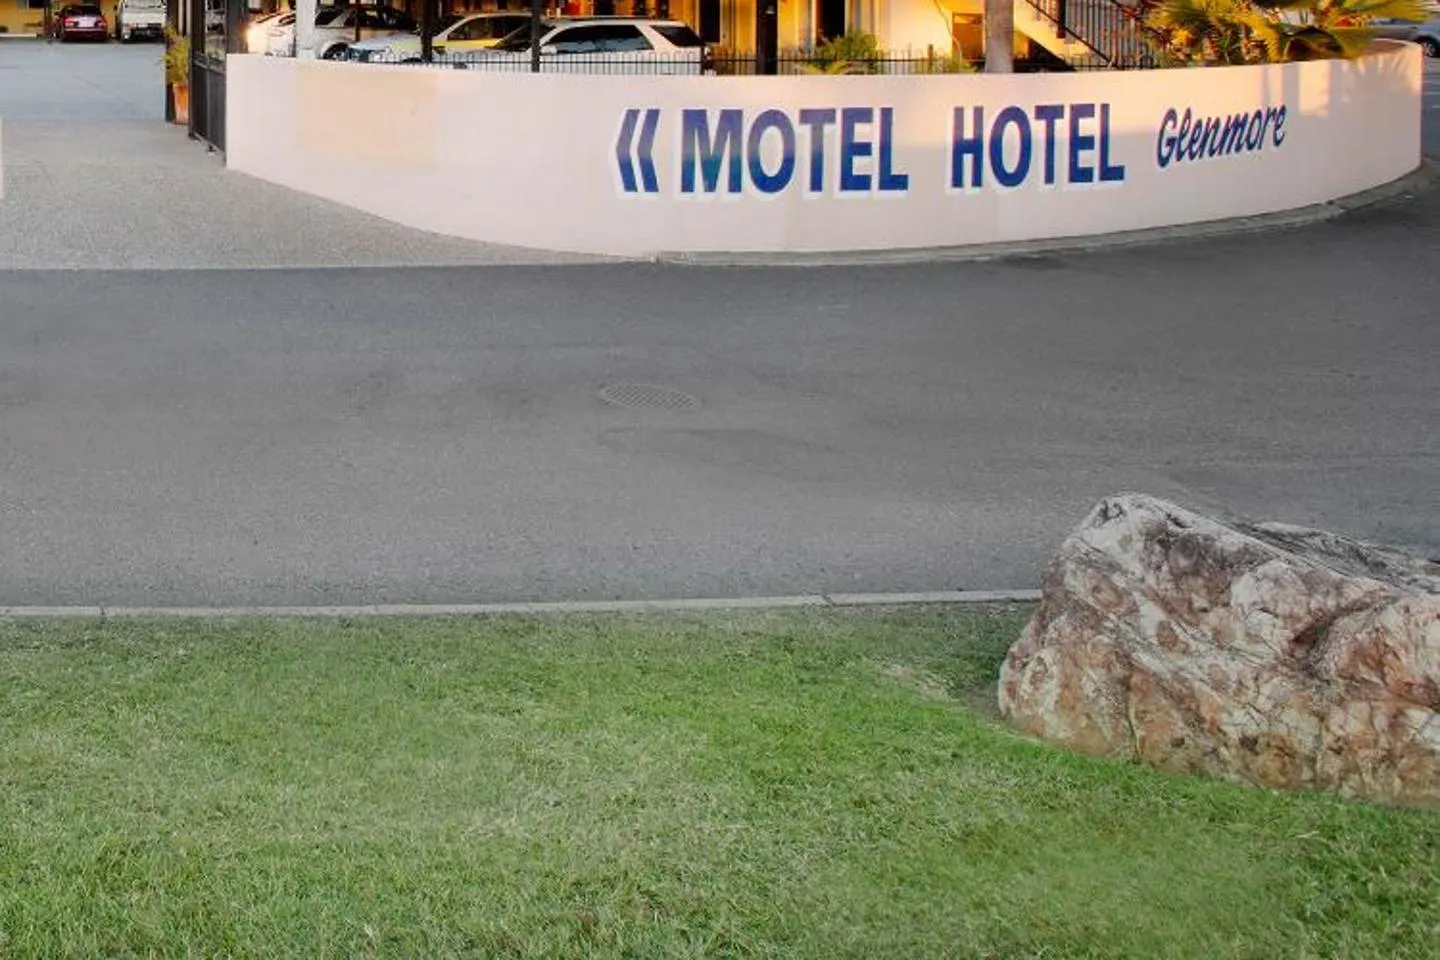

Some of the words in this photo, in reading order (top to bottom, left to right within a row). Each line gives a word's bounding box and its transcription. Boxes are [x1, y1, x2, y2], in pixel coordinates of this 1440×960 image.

[680, 106, 908, 194] MOTEL
[950, 103, 1125, 188] HOTEL
[1157, 103, 1287, 170] Glenmore
